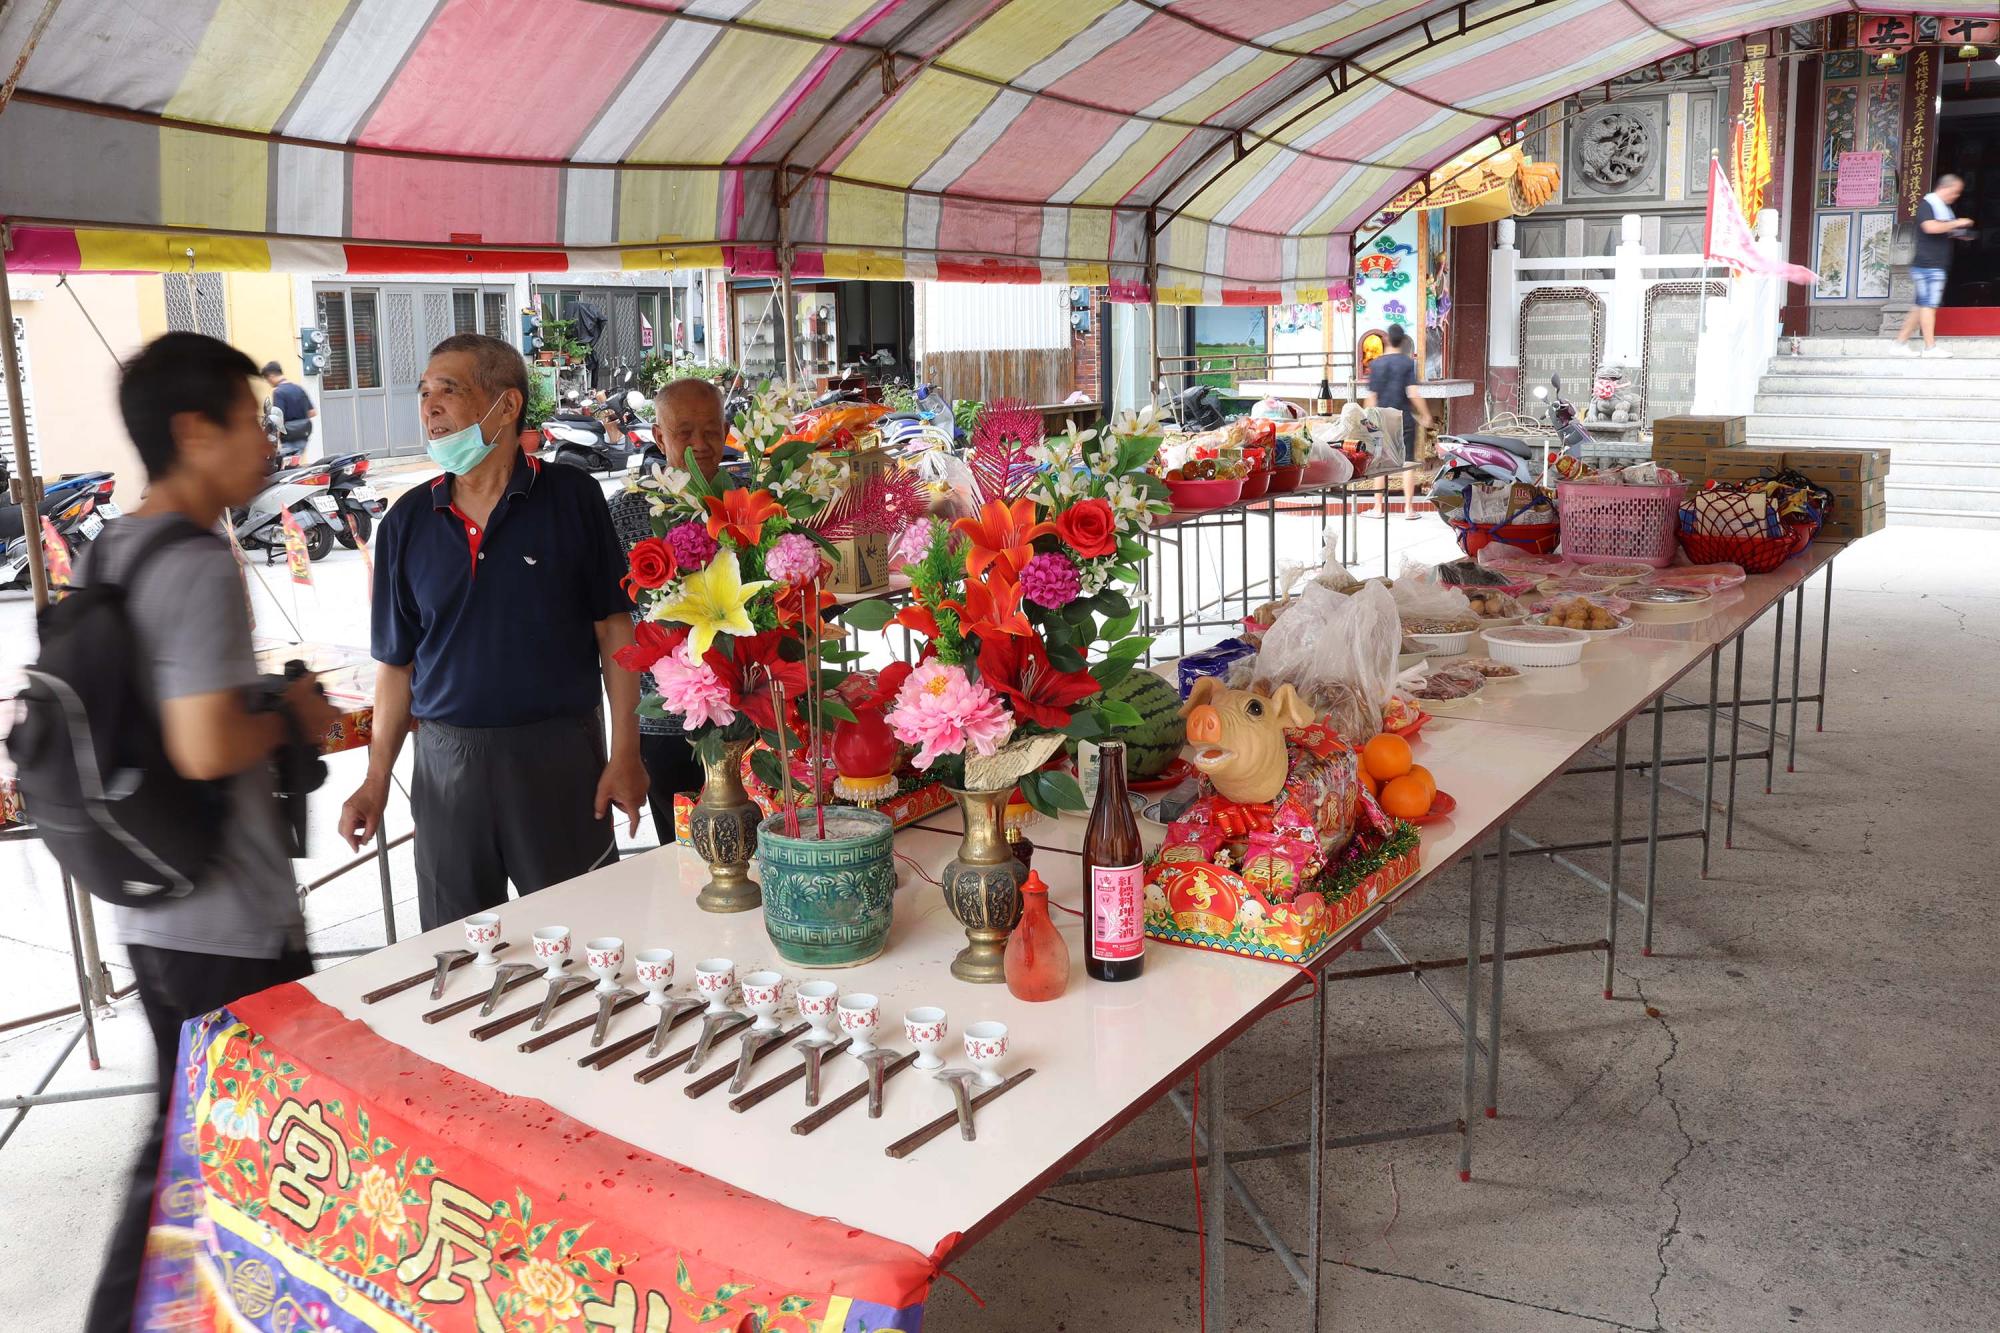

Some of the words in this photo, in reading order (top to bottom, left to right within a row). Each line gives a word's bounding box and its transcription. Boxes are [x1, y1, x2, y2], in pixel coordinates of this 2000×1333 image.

[327, 721, 345, 741] 慶
[1118, 874, 1135, 939] 紅標料理米酒
